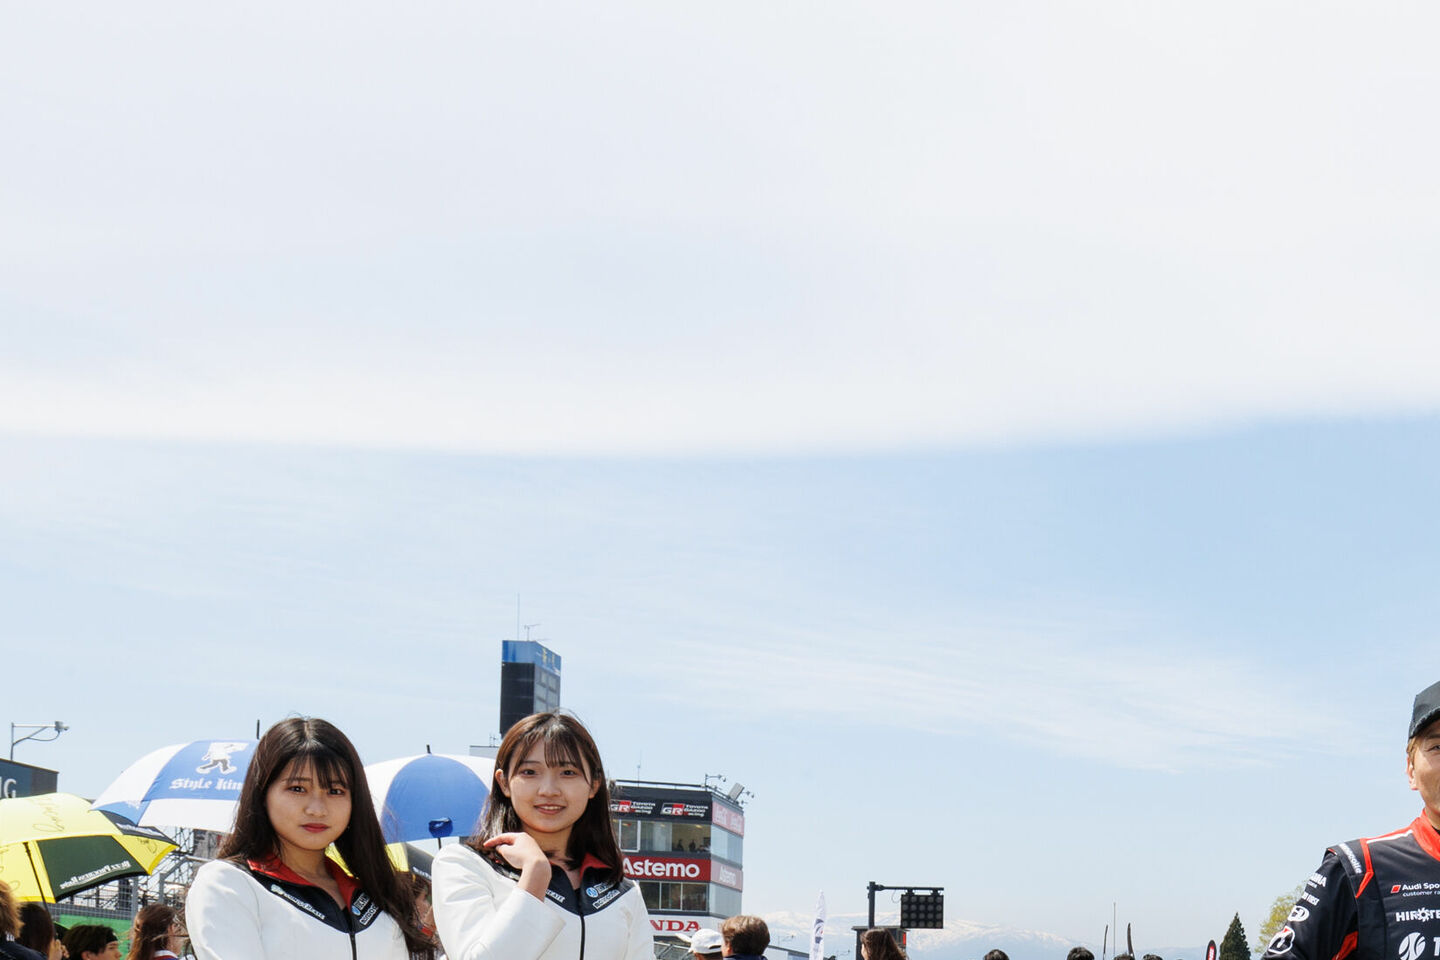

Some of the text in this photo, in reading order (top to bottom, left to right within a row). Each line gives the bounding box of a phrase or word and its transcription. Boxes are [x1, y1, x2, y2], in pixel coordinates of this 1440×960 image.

[169, 777, 210, 791] Style
[622, 857, 700, 878] Astemo
[1402, 883, 1422, 891] Audi
[650, 920, 701, 932] NDA
